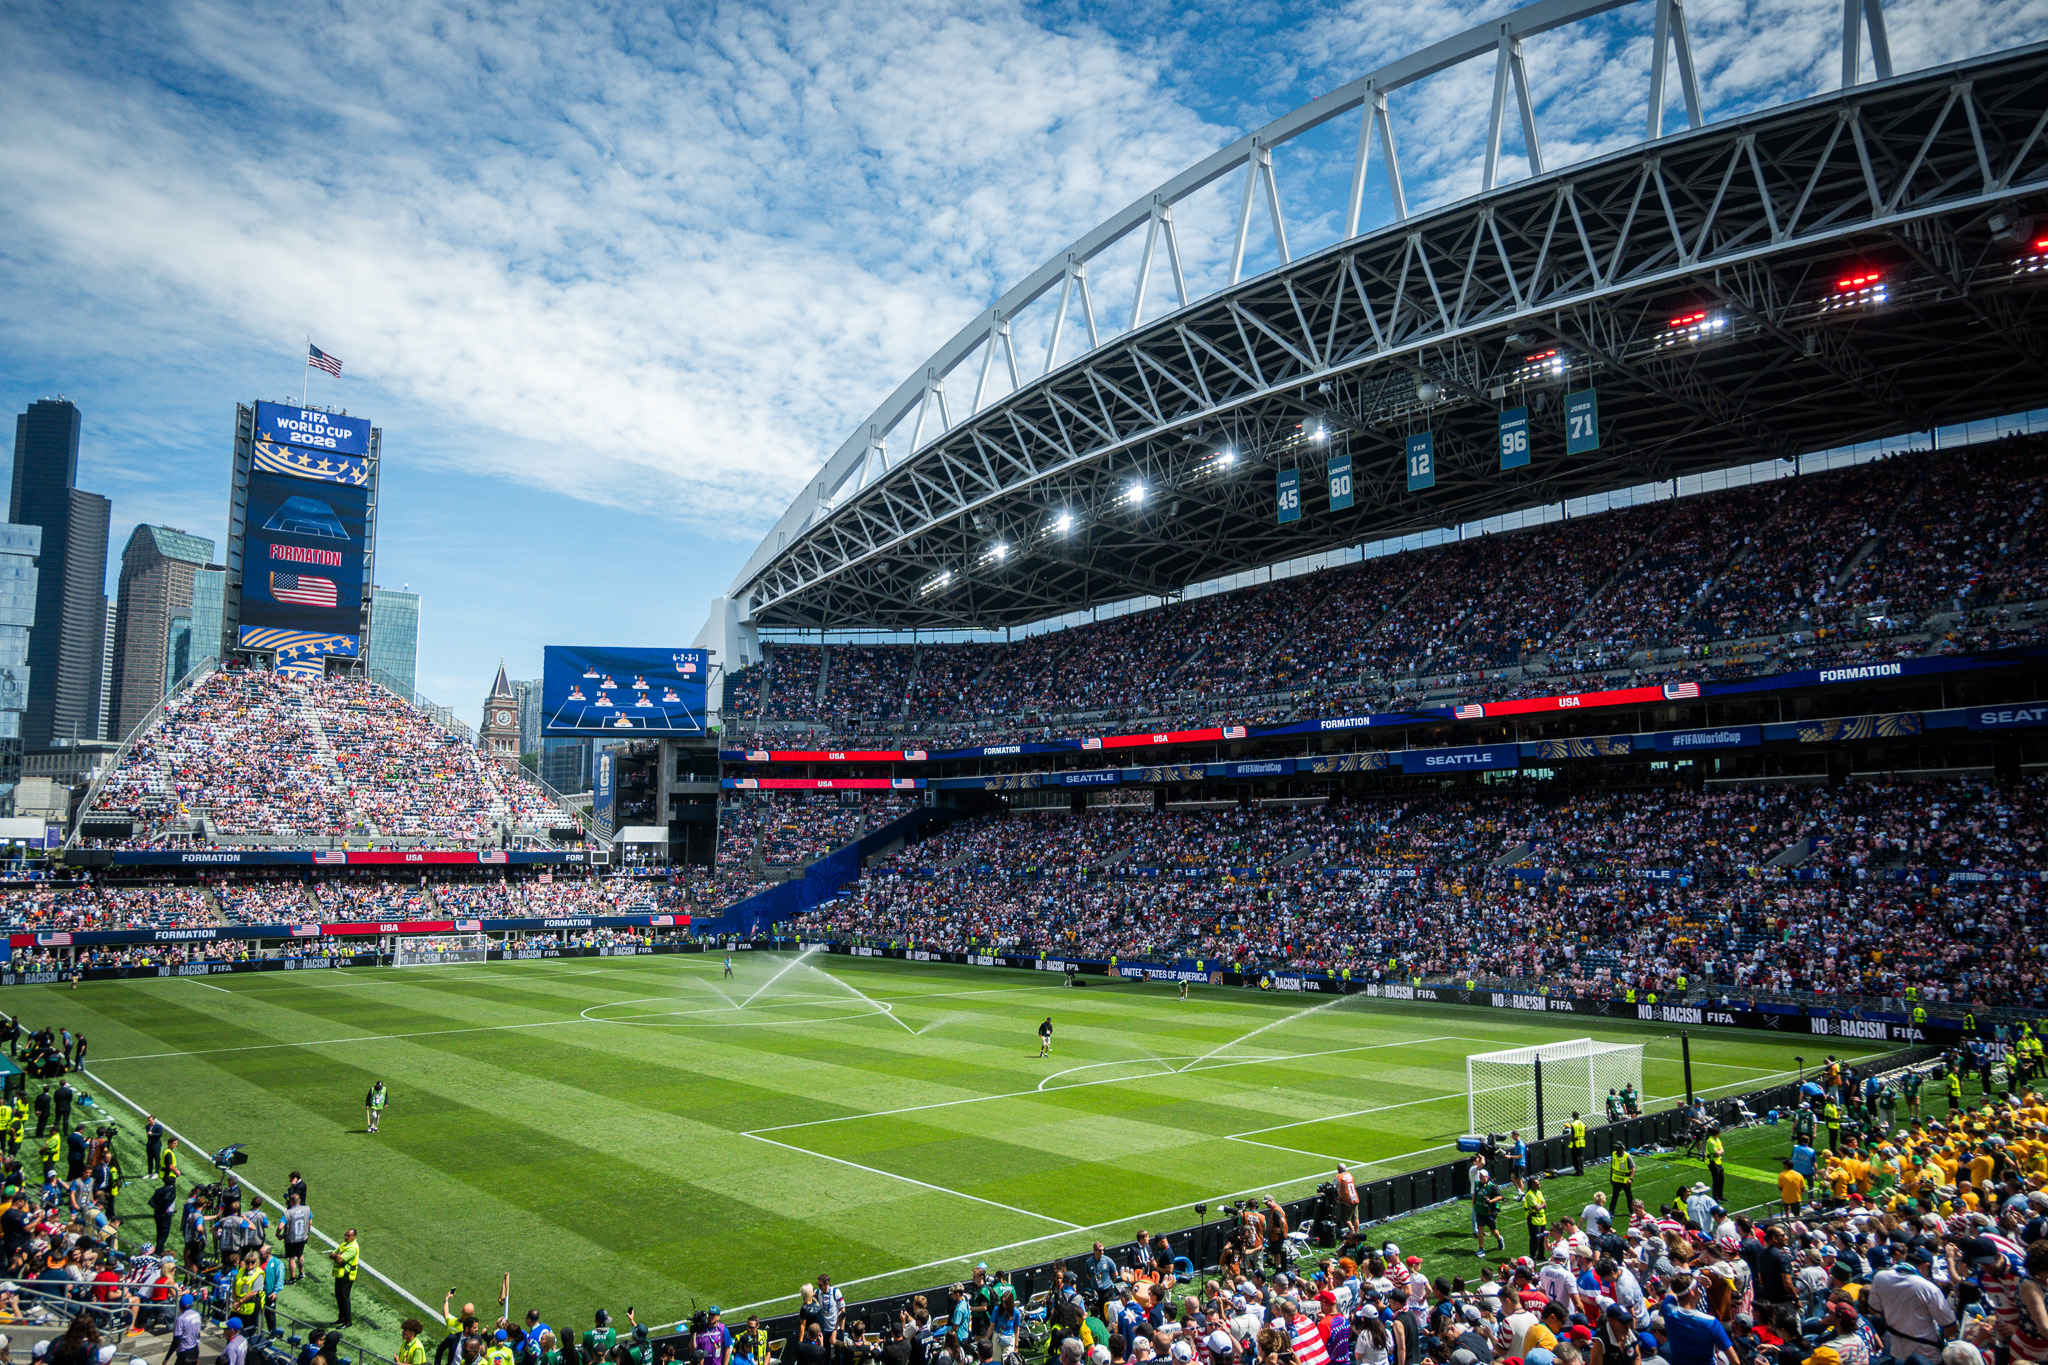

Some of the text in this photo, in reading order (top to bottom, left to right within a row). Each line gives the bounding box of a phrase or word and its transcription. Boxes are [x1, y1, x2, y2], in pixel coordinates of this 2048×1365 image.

[1570, 402, 1591, 414] JONES
[301, 410, 328, 424] FIFA
[276, 418, 352, 439] WORLD CUP
[1501, 418, 1526, 430] KENNEDY
[1570, 414, 1594, 439] 71
[290, 432, 336, 448] 2026
[1502, 430, 1527, 455] 96
[1413, 444, 1426, 452] FAN
[1328, 464, 1351, 476] LARGENT
[1411, 453, 1430, 477] 12
[1330, 475, 1350, 498] 80
[1278, 489, 1298, 510] 45
[270, 544, 342, 567] FORMATION
[1820, 663, 1901, 682] FORMATION
[1559, 697, 1580, 708] USA
[1980, 708, 2048, 724] SEAT
[1321, 717, 1370, 729] FORMATION
[1153, 735, 1168, 743] USA
[1672, 731, 1741, 746] #FIFAWorldCup
[984, 746, 1021, 755] FORMATION
[1425, 753, 1492, 765] SEATTLE
[1238, 764, 1282, 774] #FIFAWorldCup
[1066, 773, 1114, 783] SEATTLE
[182, 854, 240, 862] FORMATION
[380, 924, 398, 932] USA
[544, 919, 591, 927] FORMATION
[155, 929, 216, 939] FORMATION
[502, 950, 515, 960] NO
[518, 949, 541, 959] RACISM
[600, 947, 608, 956] NO
[614, 946, 636, 955] RACISM
[284, 960, 295, 970] NO
[303, 957, 330, 968] RACISM
[1035, 960, 1042, 970] NO
[1047, 960, 1064, 971] RACISM
[158, 966, 170, 976] NO
[178, 964, 209, 975] RACISM
[2, 974, 16, 984] NO
[25, 972, 58, 984] RACISM
[1168, 971, 1176, 980] OF
[1177, 971, 1208, 982] AMERICA
[1275, 977, 1300, 990] RACISM
[1303, 981, 1320, 990] FIFA
[1367, 984, 1437, 1000] NO RACISM FIFA
[1492, 993, 1573, 1011] NO RACISM FIFA
[1638, 1004, 1734, 1024] NO RACISM FIFA
[1811, 1017, 1924, 1040] NO RACISM FIFA
[1549, 1281, 1557, 1301] 4
[1524, 1300, 1546, 1309] DEMPSE
